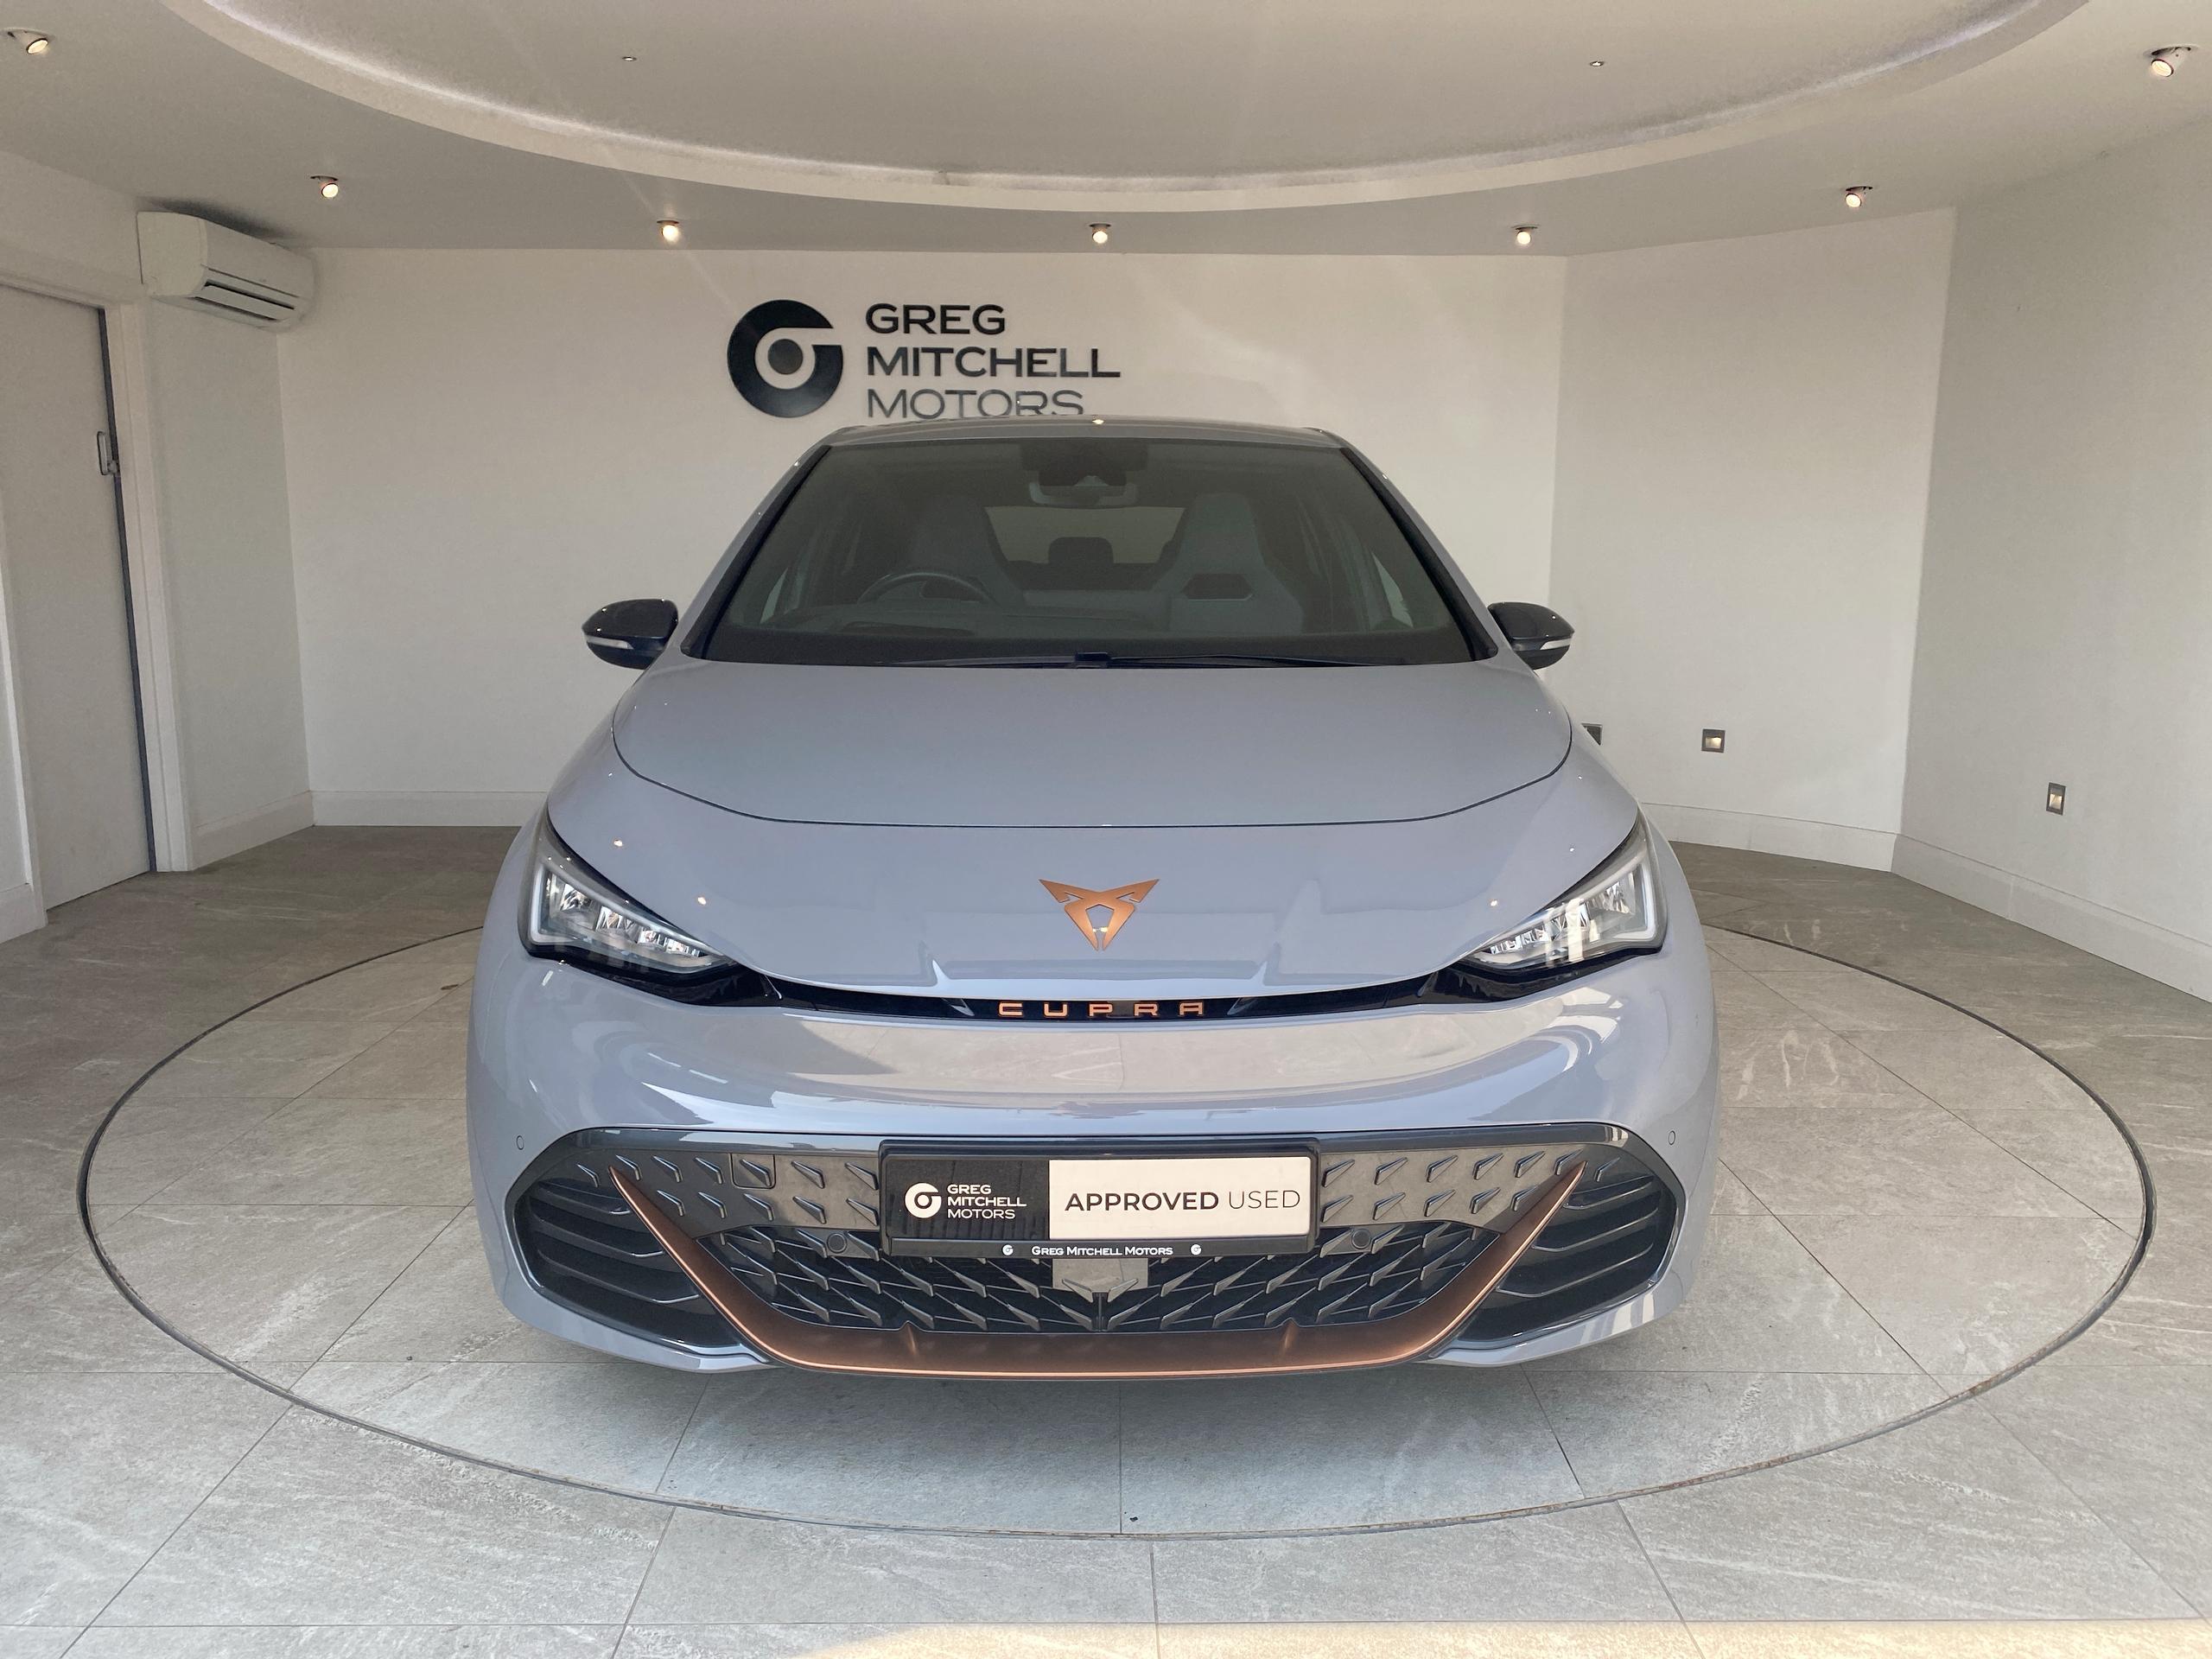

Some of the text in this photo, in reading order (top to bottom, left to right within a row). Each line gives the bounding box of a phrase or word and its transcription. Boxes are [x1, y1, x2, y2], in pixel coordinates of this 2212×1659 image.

[865, 303, 1006, 335] GREG
[867, 346, 1122, 378] MITCHELL
[867, 388, 1084, 420] MOTORS
[998, 1001, 1204, 1018] CUPRA
[947, 1184, 992, 1195] GREG
[947, 1196, 1027, 1207] MITCHELL
[1065, 1189, 1301, 1211] APPROVED USED
[947, 1208, 1016, 1220] MOTORS
[1031, 1245, 1065, 1256] GREG
[1124, 1246, 1173, 1256] MOTORS
